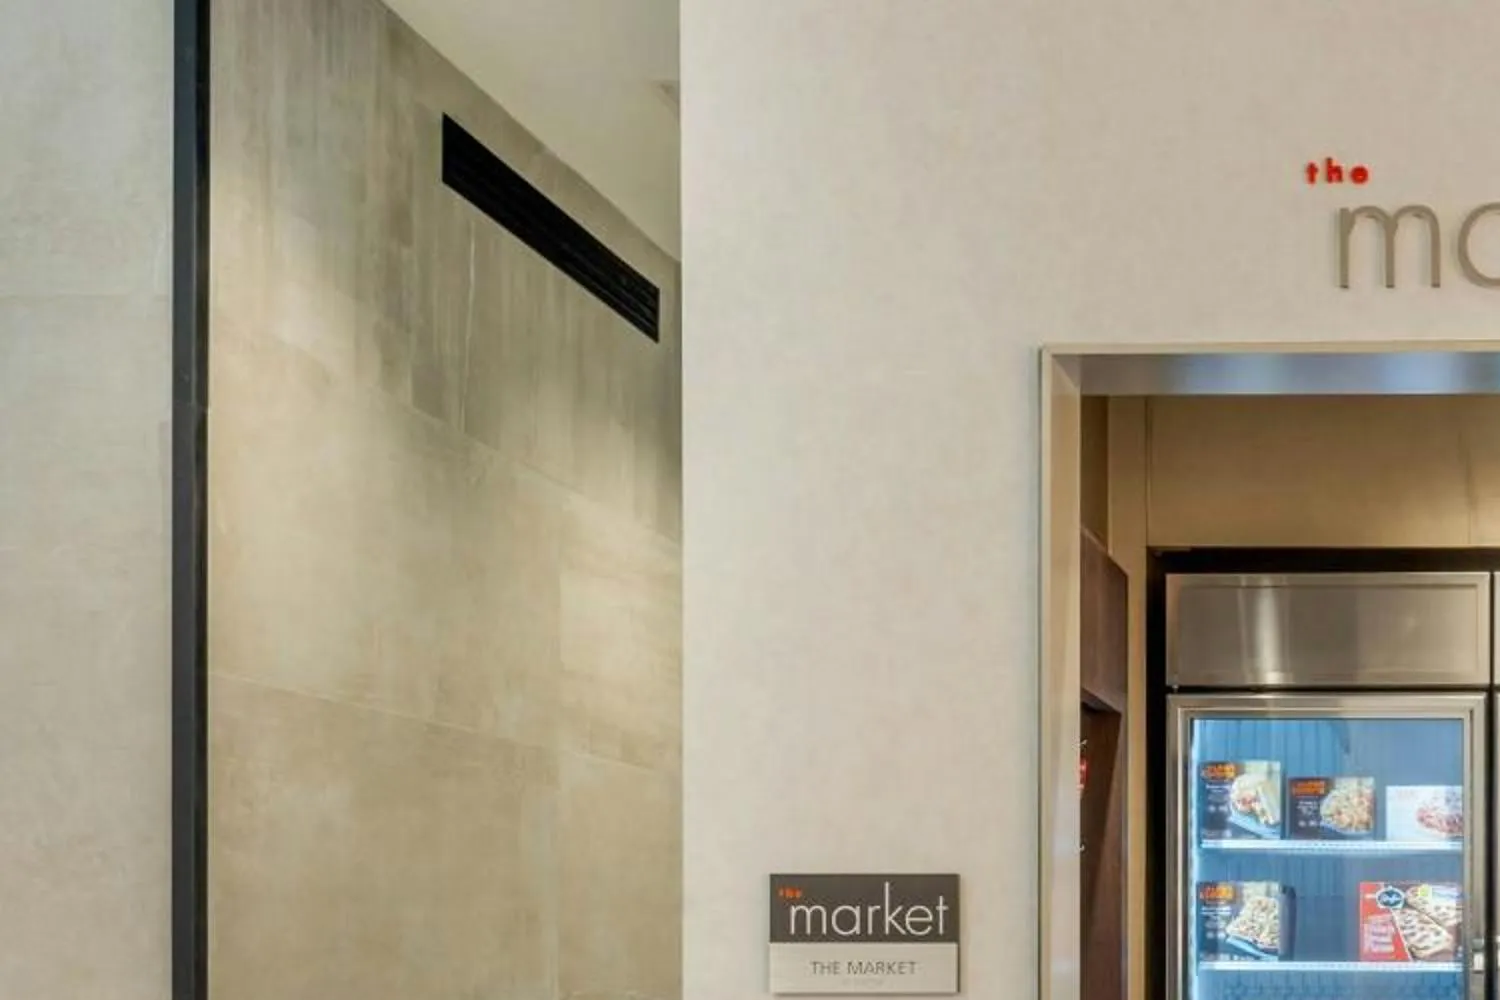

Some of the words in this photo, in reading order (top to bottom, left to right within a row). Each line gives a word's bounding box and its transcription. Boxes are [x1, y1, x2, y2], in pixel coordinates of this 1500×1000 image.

[1304, 157, 1369, 184] the
[789, 881, 949, 935] market
[811, 961, 841, 975] THE
[847, 961, 917, 975] MARKET
